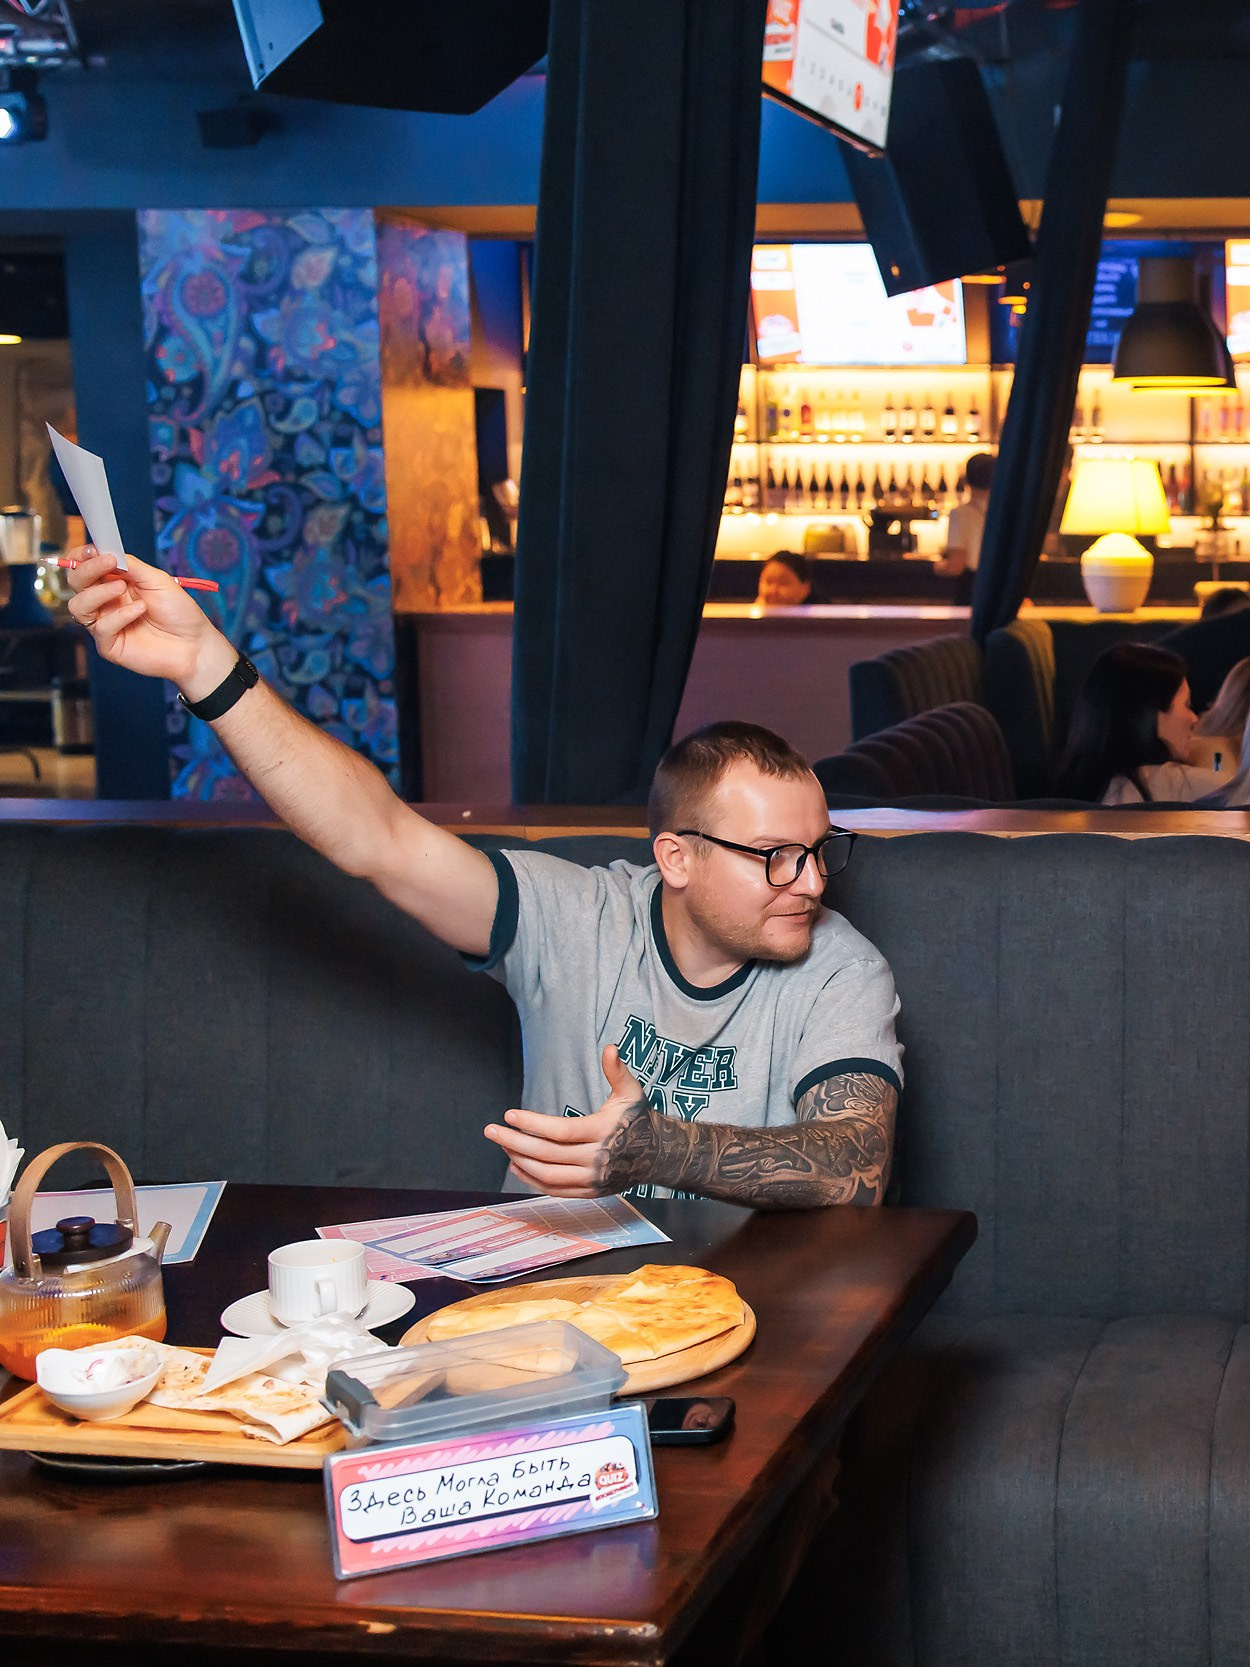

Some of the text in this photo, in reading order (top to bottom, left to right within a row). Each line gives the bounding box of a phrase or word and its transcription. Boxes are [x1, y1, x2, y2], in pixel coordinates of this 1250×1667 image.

[636, 1075, 710, 1123] AY
[347, 1486, 427, 1514] Здесь
[436, 1472, 500, 1496] Могла
[400, 1500, 472, 1526] Ваша
[483, 1473, 591, 1508] Команда
[598, 1470, 626, 1486] QUIZ
